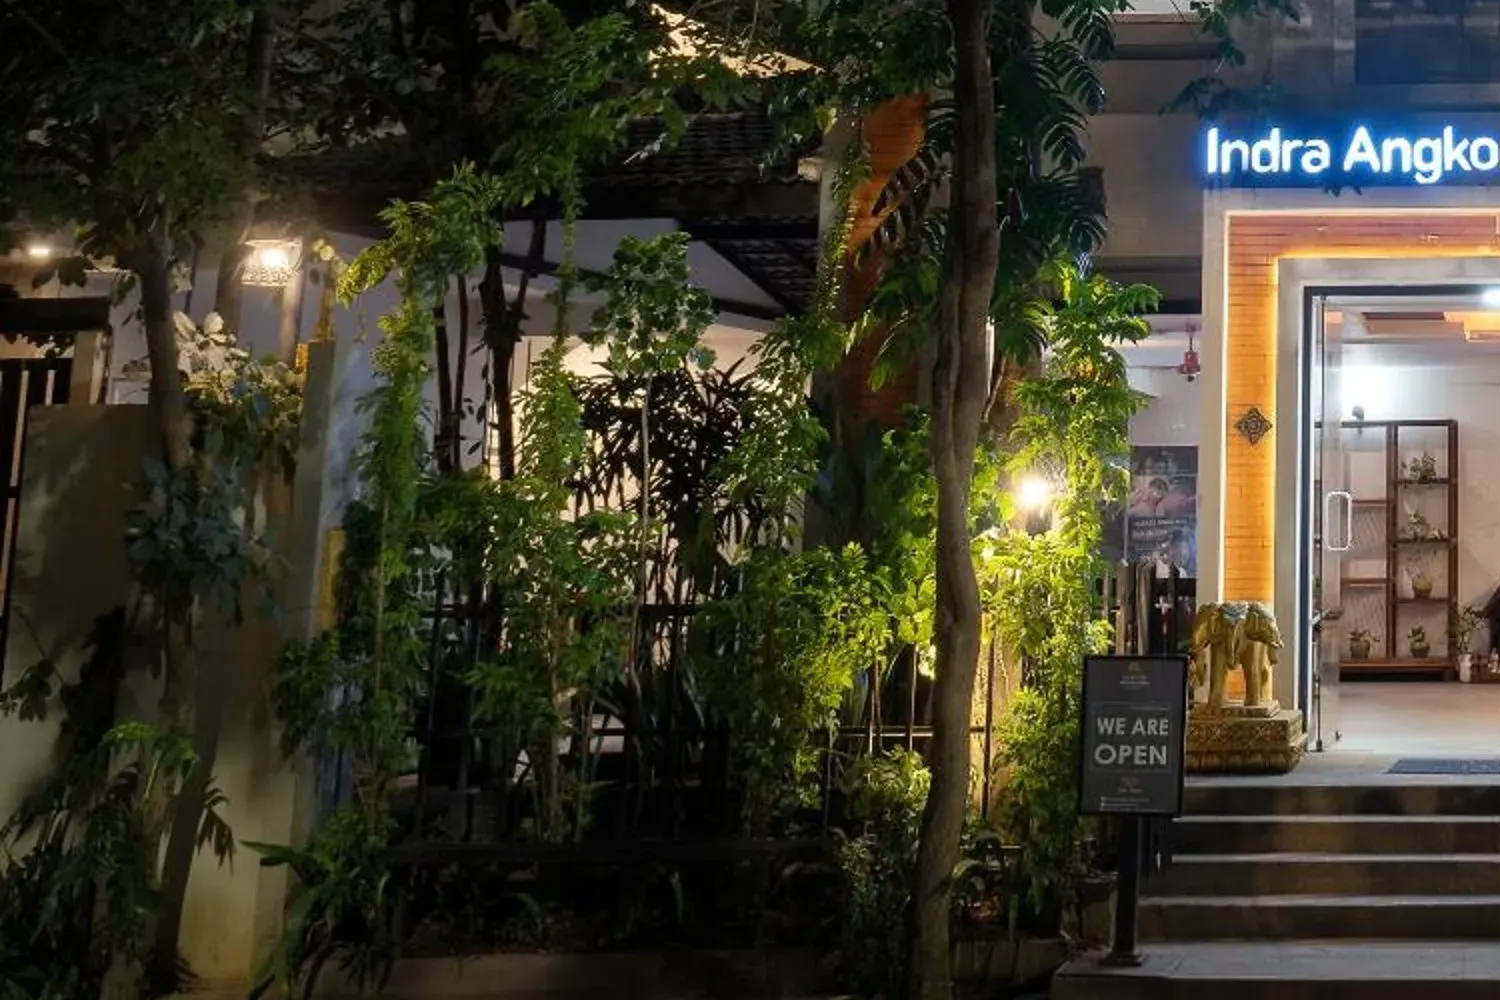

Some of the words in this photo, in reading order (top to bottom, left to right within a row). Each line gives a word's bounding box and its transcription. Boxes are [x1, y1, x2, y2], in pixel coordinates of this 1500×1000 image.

[1207, 127, 1330, 174] Indra
[1097, 718, 1126, 736] WE
[1131, 718, 1169, 736] ARE
[1094, 743, 1167, 765] OPEN
